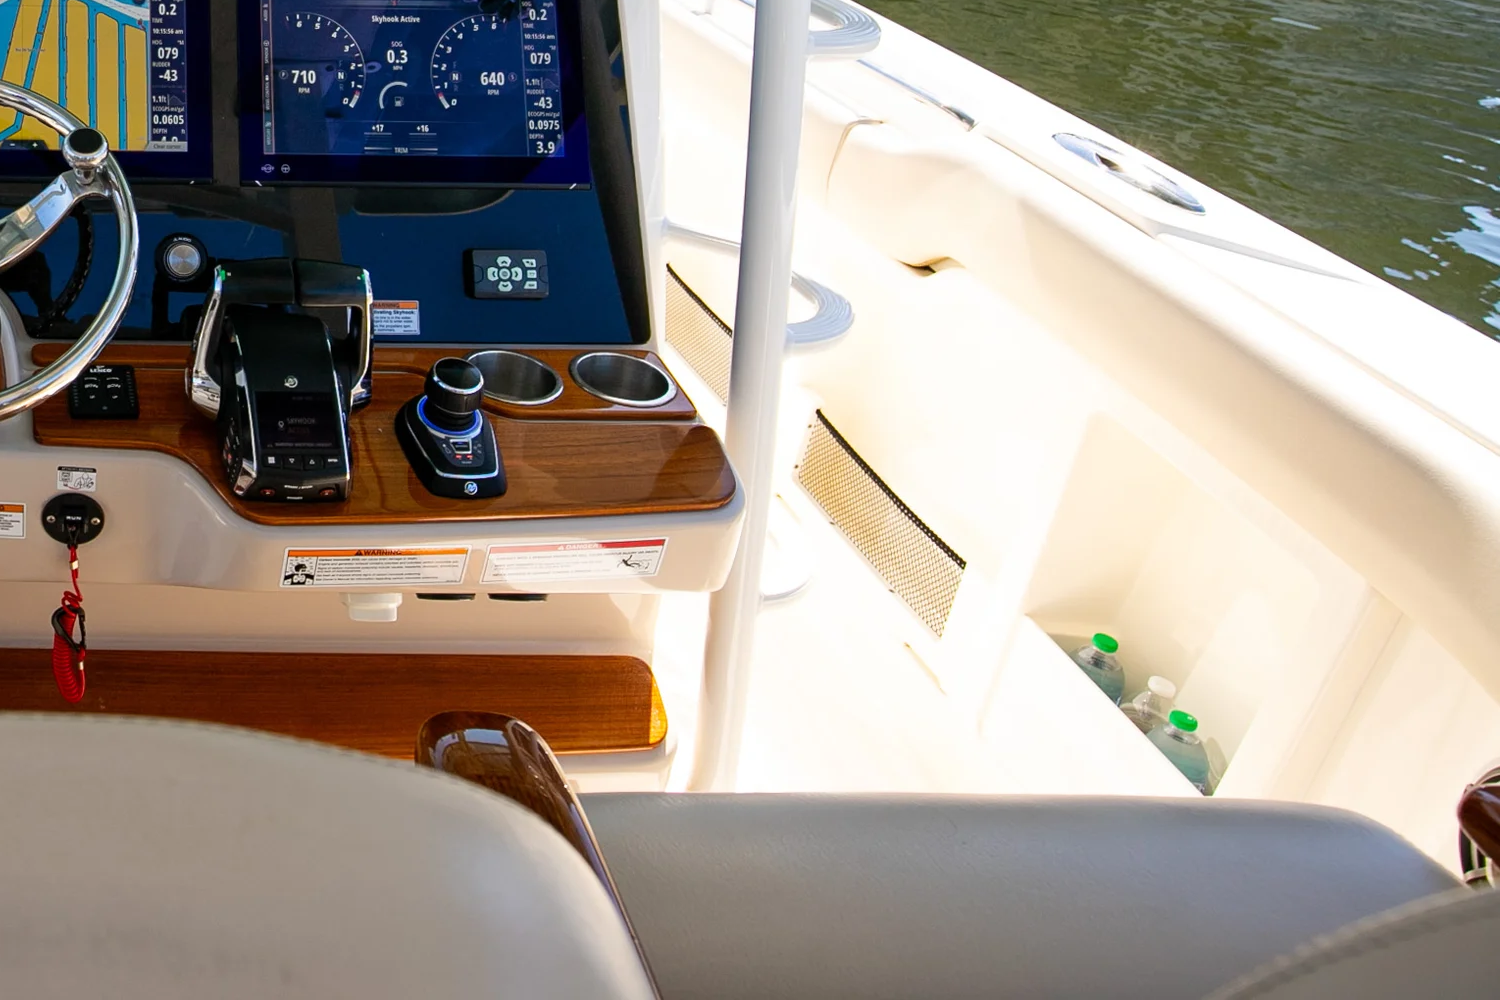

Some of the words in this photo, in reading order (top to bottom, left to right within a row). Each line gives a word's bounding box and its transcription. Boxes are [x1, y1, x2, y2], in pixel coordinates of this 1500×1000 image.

[158, 3, 177, 15] 0.2
[529, 8, 547, 20] 0.2
[371, 15, 399, 24] Skyhook
[157, 47, 179, 59] 079
[386, 50, 408, 63] 0.3
[530, 52, 551, 64] 079
[159, 69, 179, 81] -43
[291, 70, 316, 84] 710
[480, 72, 505, 86] 640
[534, 96, 553, 109] -43
[153, 114, 184, 125] 0.0605
[528, 120, 560, 130] 0.0975
[372, 124, 384, 132] +17
[536, 141, 555, 154] 3.9
